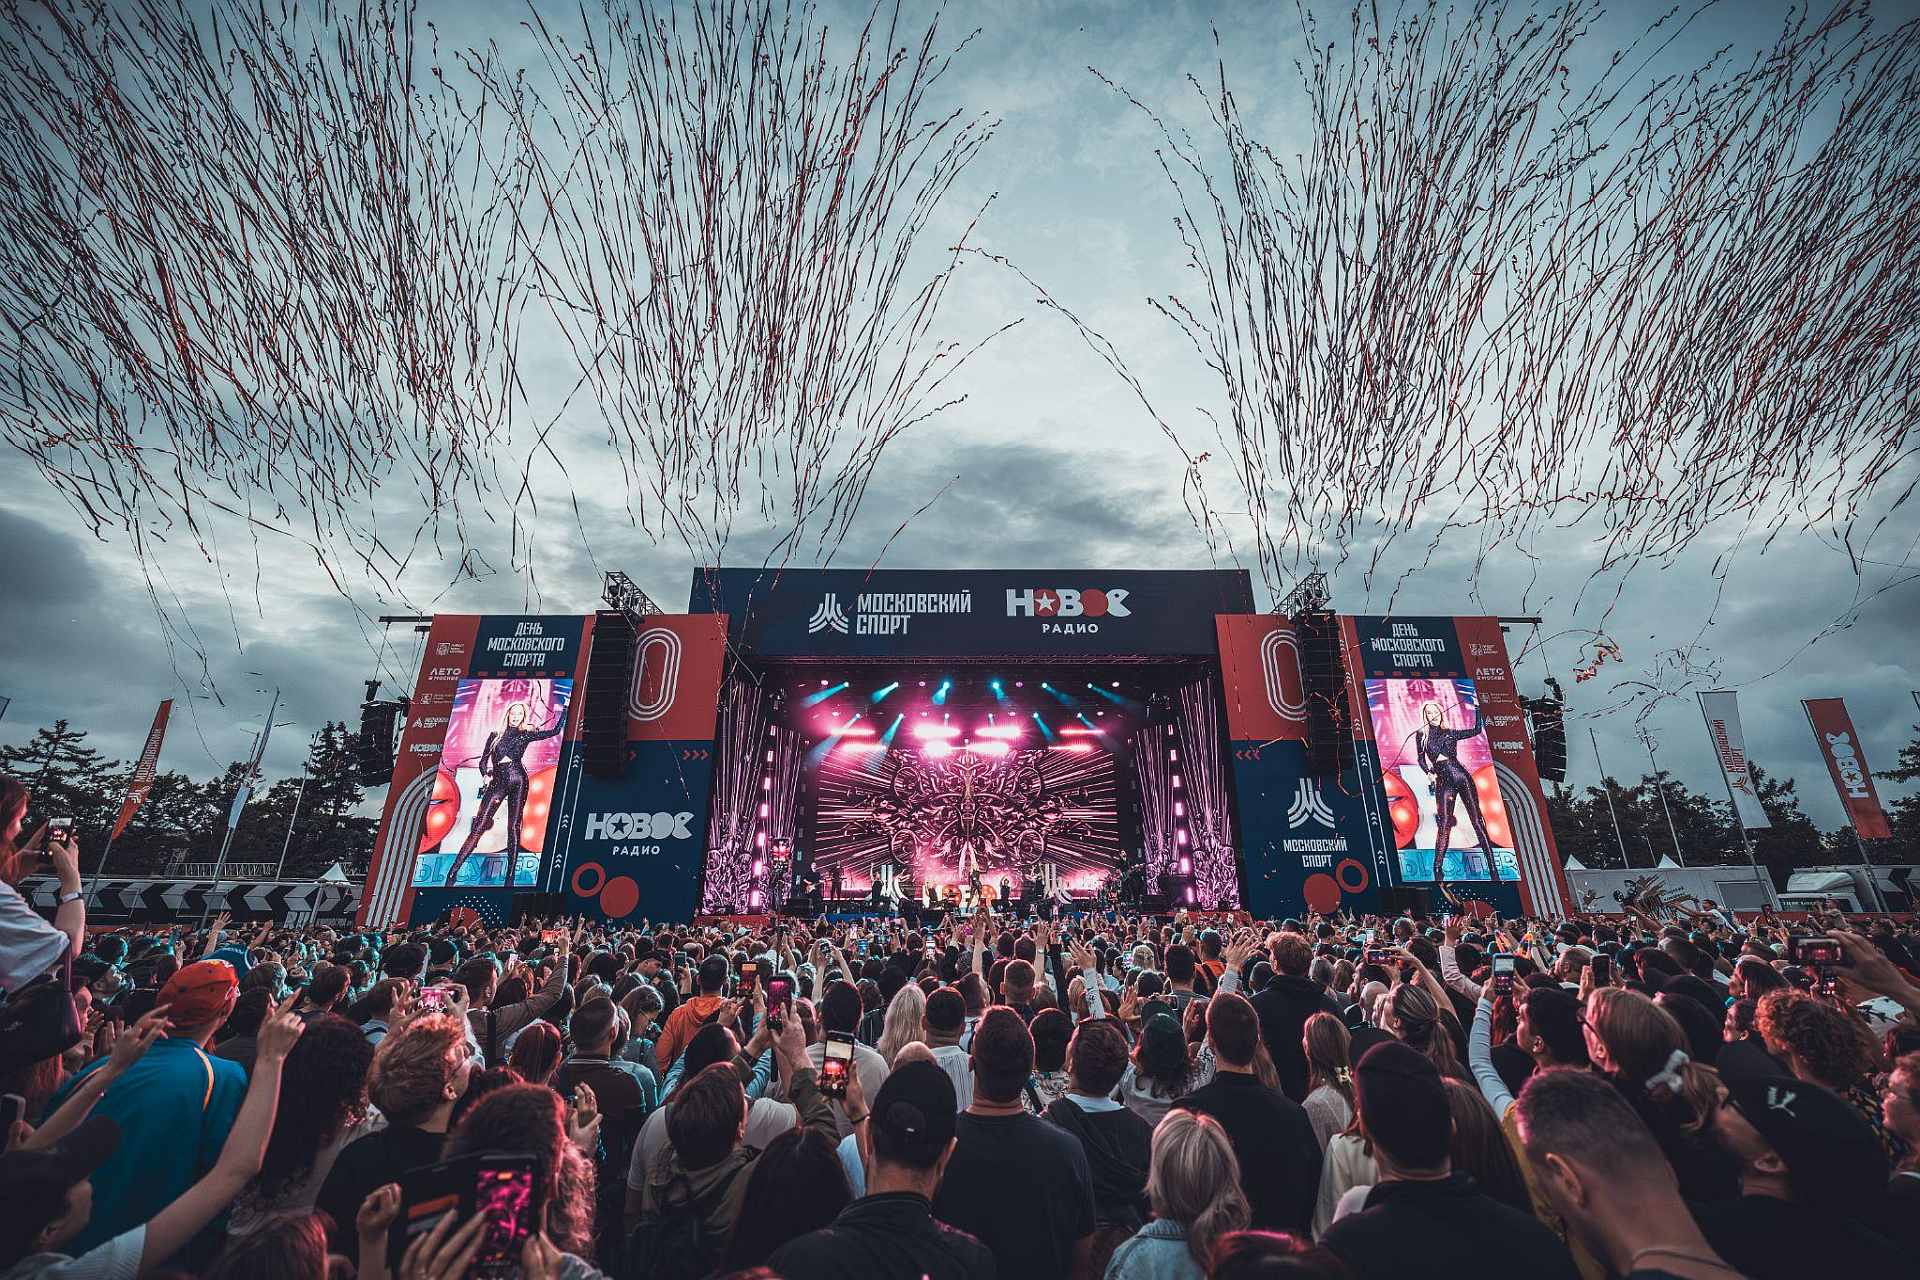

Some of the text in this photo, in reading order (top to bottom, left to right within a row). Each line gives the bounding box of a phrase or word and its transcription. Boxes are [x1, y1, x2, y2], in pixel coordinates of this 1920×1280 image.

[856, 590, 972, 613] МОСКОВСКИЙ
[515, 622, 544, 637] ДЕНЬ
[856, 615, 911, 635] СПОРТ
[1042, 624, 1099, 635] РАДИО
[1392, 623, 1419, 638] ДЕНЬ
[487, 637, 565, 652] МОСКОВСКОГО
[1370, 637, 1446, 652] МОСКОВСКОГО
[503, 653, 546, 667] СПОРТА
[1393, 653, 1434, 668] СПОРТА
[430, 667, 462, 676] ЛЕТО
[1476, 667, 1505, 676] ЛЕТО
[612, 845, 660, 856] РАДИО
[1283, 836, 1348, 852] МОСКОВСКИЙ
[1303, 855, 1332, 867] СПОРТ
